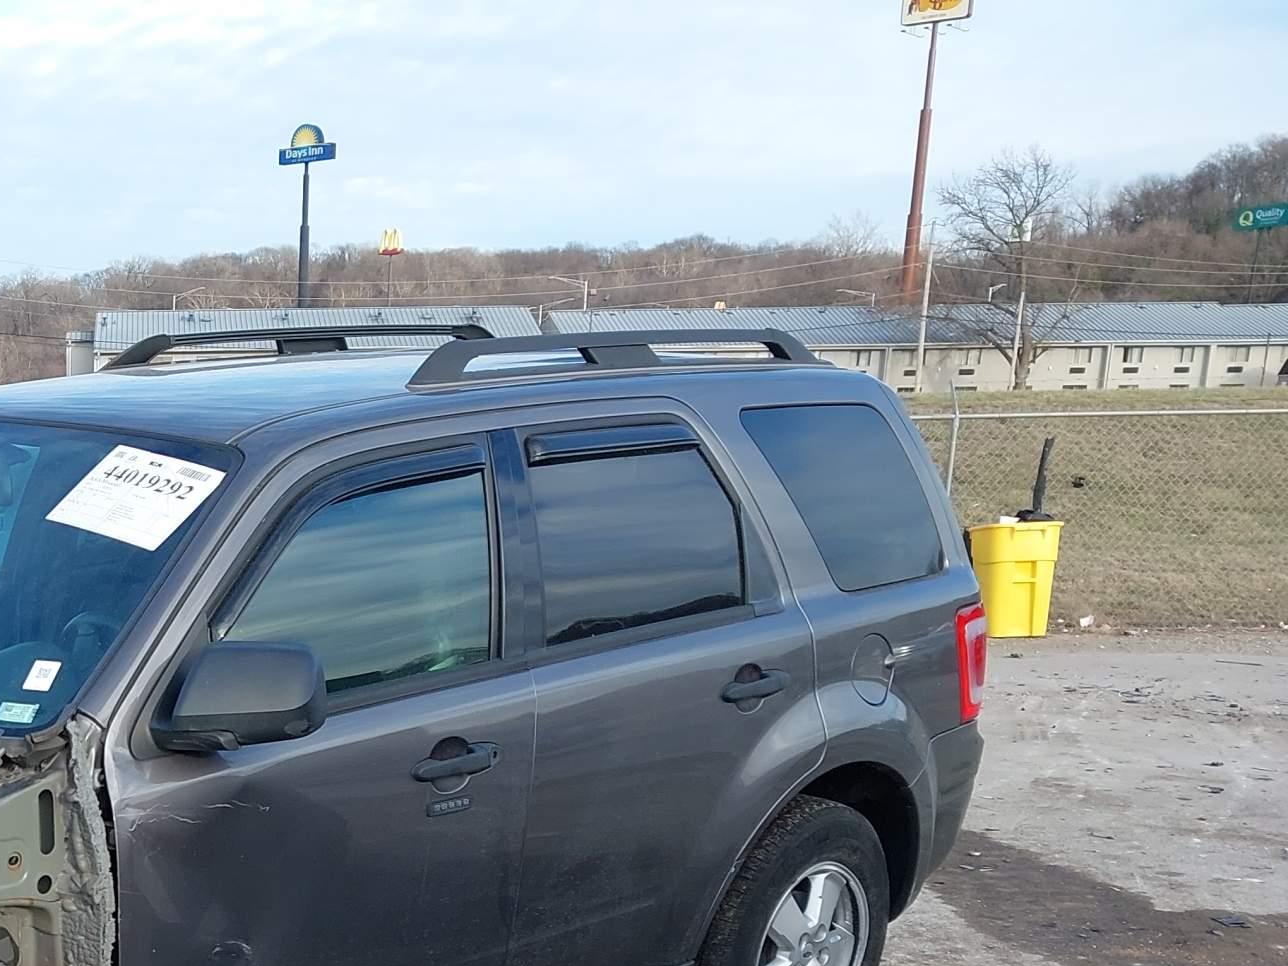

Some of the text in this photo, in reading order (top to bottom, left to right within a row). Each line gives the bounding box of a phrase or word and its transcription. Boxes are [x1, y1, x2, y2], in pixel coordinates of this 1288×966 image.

[285, 149, 307, 160] Days
[308, 146, 324, 156] Inn
[1256, 208, 1285, 219] Quality
[104, 465, 195, 501] 44019292
